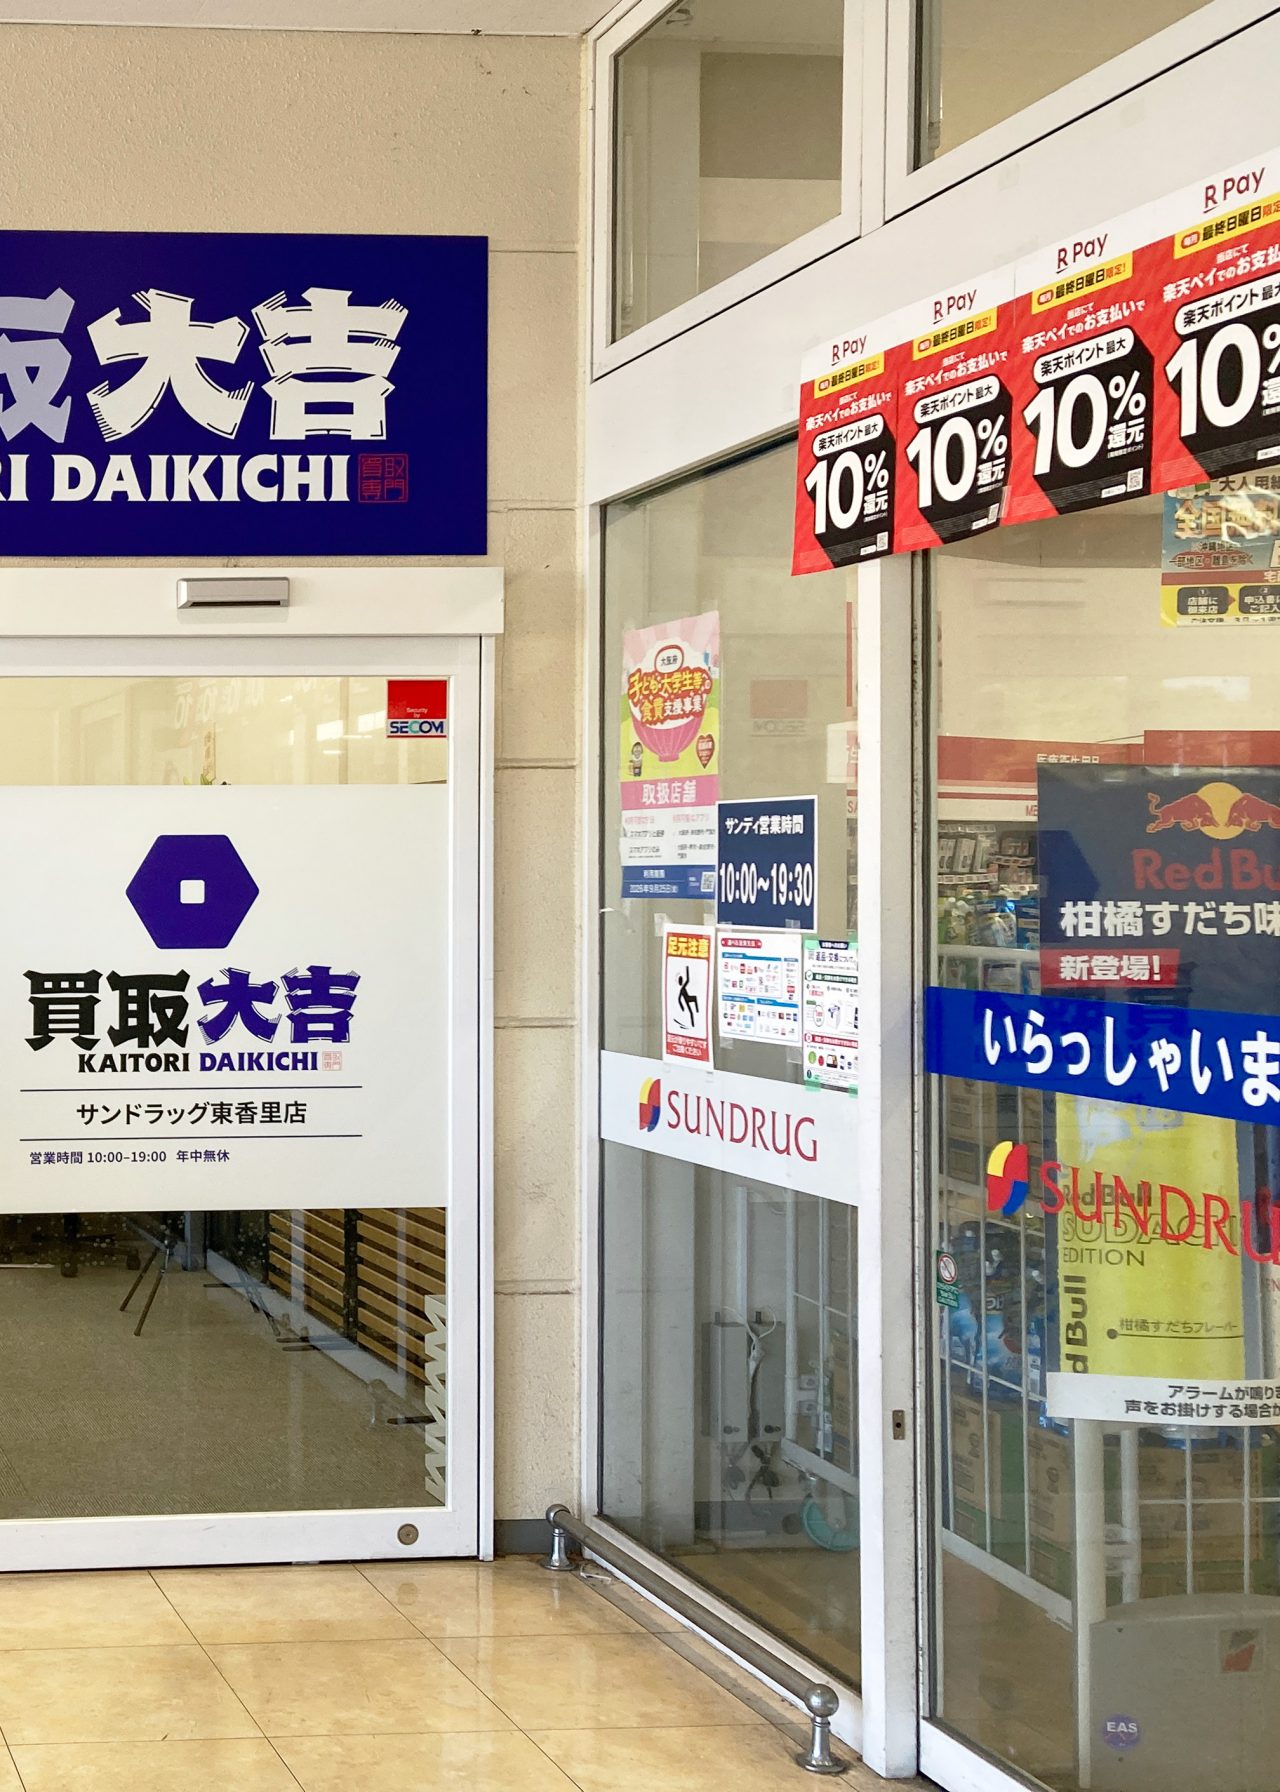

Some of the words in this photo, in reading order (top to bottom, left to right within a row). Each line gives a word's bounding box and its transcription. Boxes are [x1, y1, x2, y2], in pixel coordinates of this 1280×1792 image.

[1223, 167, 1265, 200] Pay
[1073, 234, 1108, 262] Pay
[947, 289, 977, 318] Pay
[1183, 288, 1259, 328] 楽天ポイント
[843, 335, 867, 358] Pay
[1040, 342, 1104, 377] 楽天ポイント
[920, 389, 974, 418] 楽天ポイント
[1107, 417, 1145, 450] 還元
[50, 453, 351, 503] DAIKICHI
[976, 457, 1006, 486] 還元
[863, 492, 888, 516] 還元
[390, 721, 444, 734] SECOM
[642, 780, 697, 805] 取扱店舗
[725, 814, 804, 835] サンディ営業時間
[1132, 849, 1222, 890] Red
[1231, 850, 1280, 890] Bu
[1060, 900, 1280, 937] 柑橘すだち味
[668, 936, 709, 958] 足元注意
[1060, 955, 1160, 981] 新登場!
[23, 965, 361, 1051] 買取大吉
[77, 1053, 190, 1072] KAITORI
[199, 1051, 318, 1071] DAIKICHI
[984, 1008, 1280, 1107] いらっしゃいま
[76, 1101, 307, 1126] サンドラッグ東香里店
[668, 1089, 818, 1163] SUNDRUG
[29, 1151, 83, 1164] 営業時間
[176, 1149, 230, 1162] 年中無休
[1040, 1160, 1280, 1265] SUNDRU
[1063, 1248, 1145, 1266] EDITION
[1063, 1275, 1088, 1347] Bull
[1120, 1317, 1238, 1334] 柑橘すだちフレーバー
[1107, 1722, 1137, 1733] EAS
